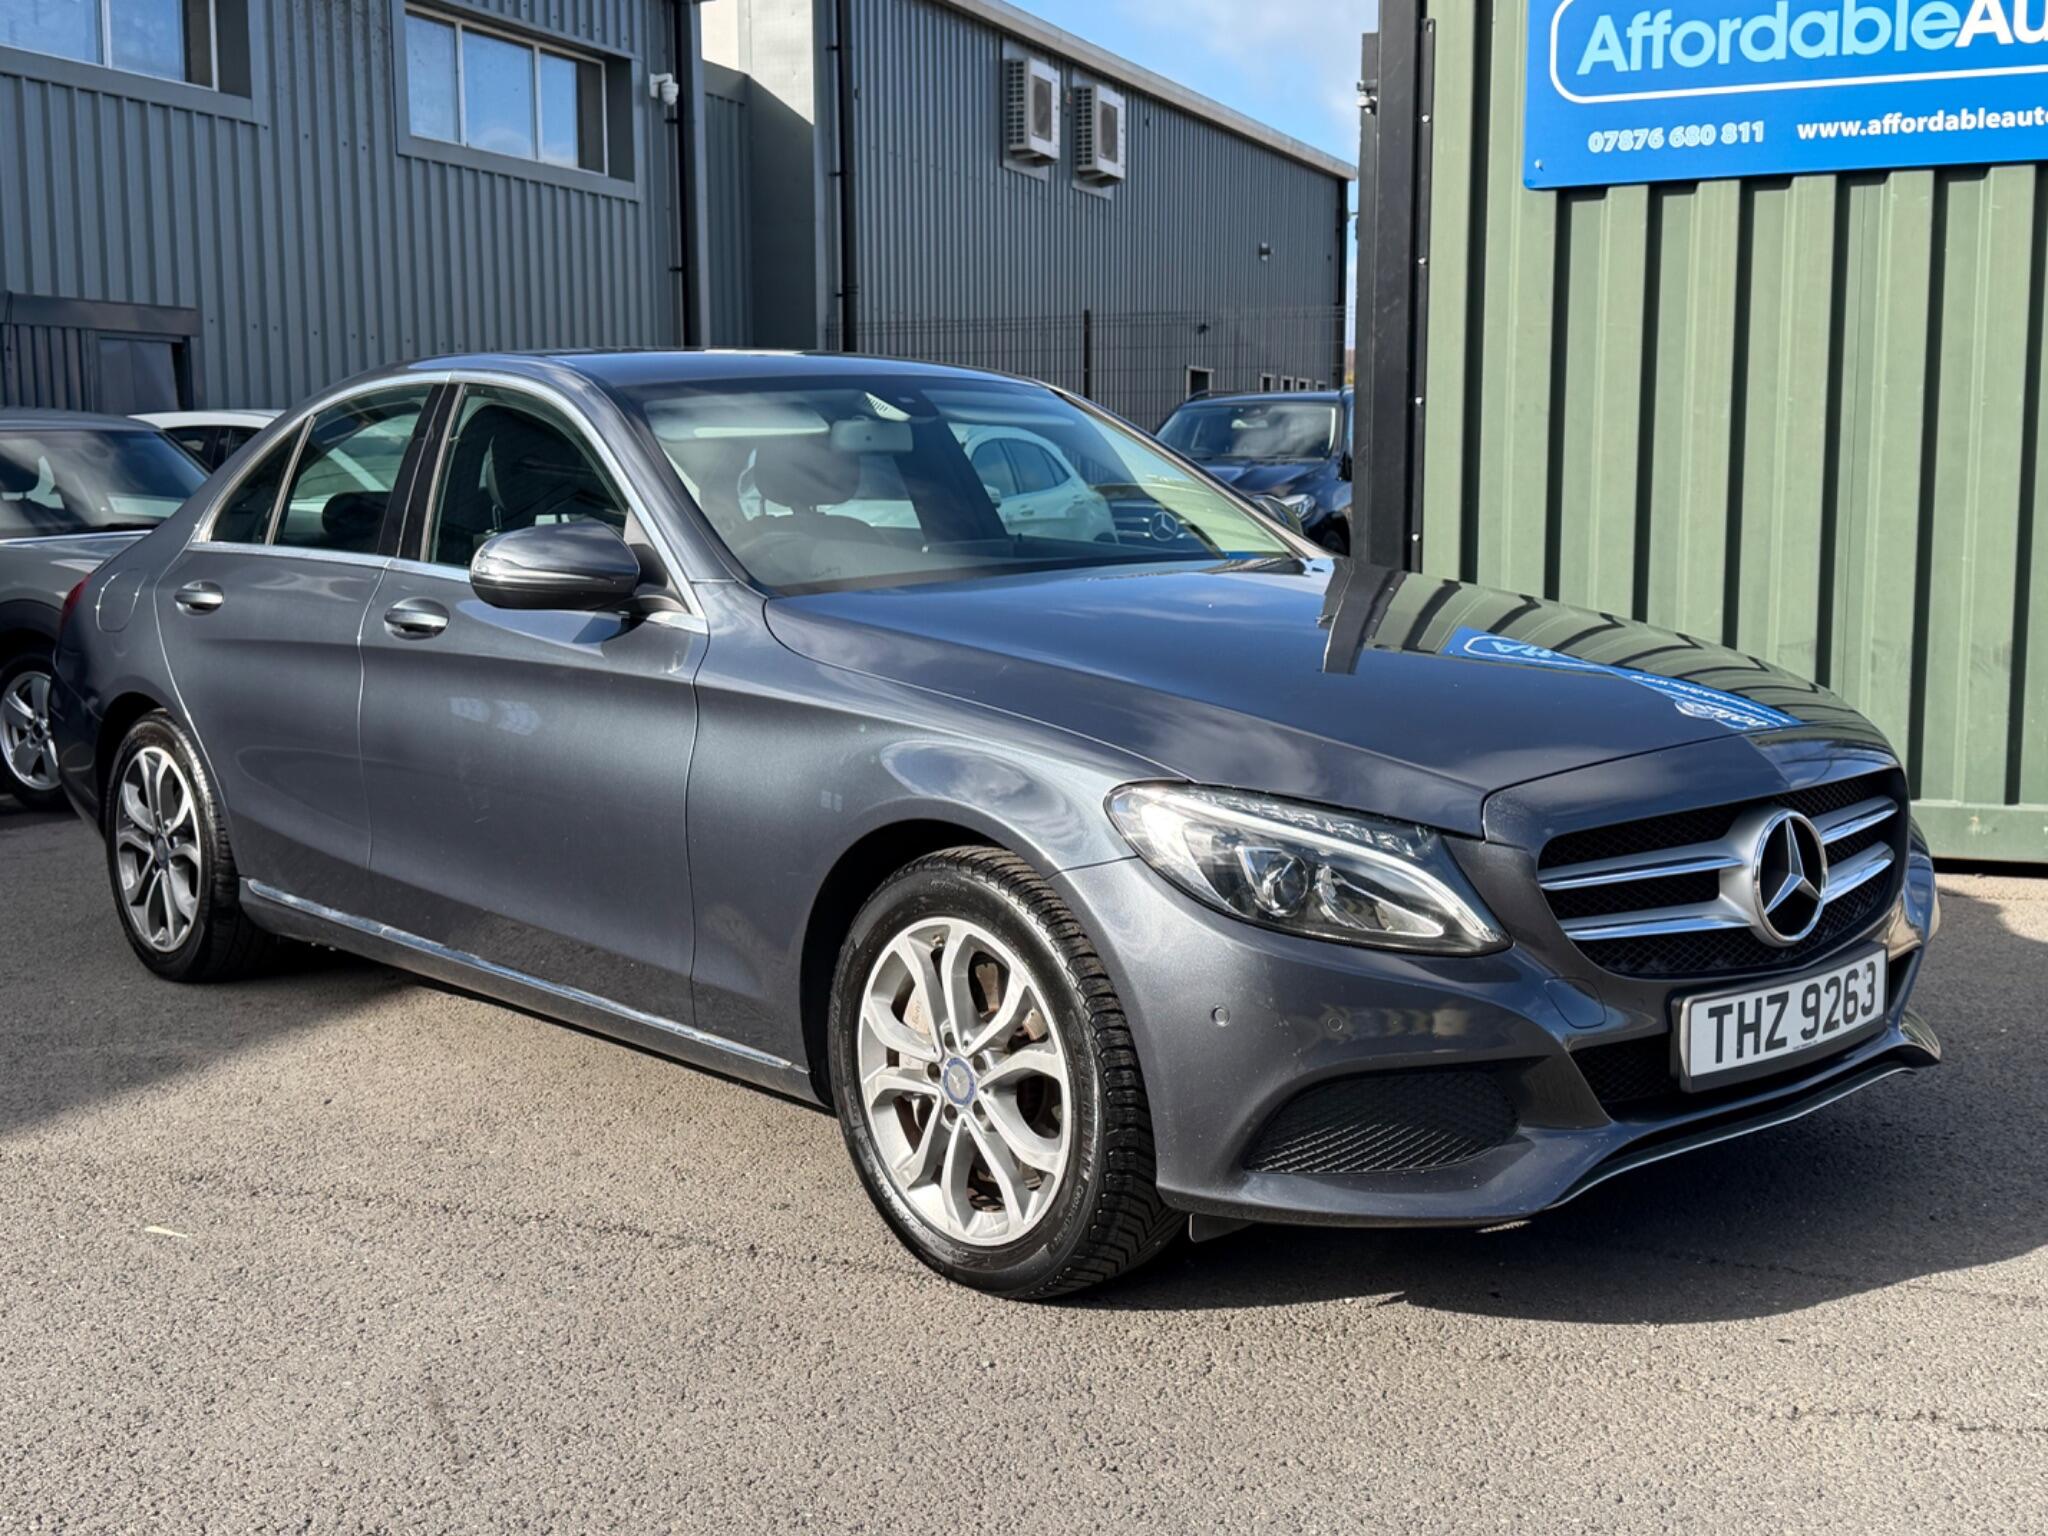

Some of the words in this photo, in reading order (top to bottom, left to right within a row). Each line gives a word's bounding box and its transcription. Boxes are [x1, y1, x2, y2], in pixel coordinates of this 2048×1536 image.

[1587, 127, 1664, 153] 07876
[1668, 123, 1717, 148] 680
[1720, 120, 1765, 145] 811
[1797, 106, 2048, 140] www.affordableaut
[1707, 990, 1790, 1064] THZ
[1799, 960, 1877, 1041] 9263
